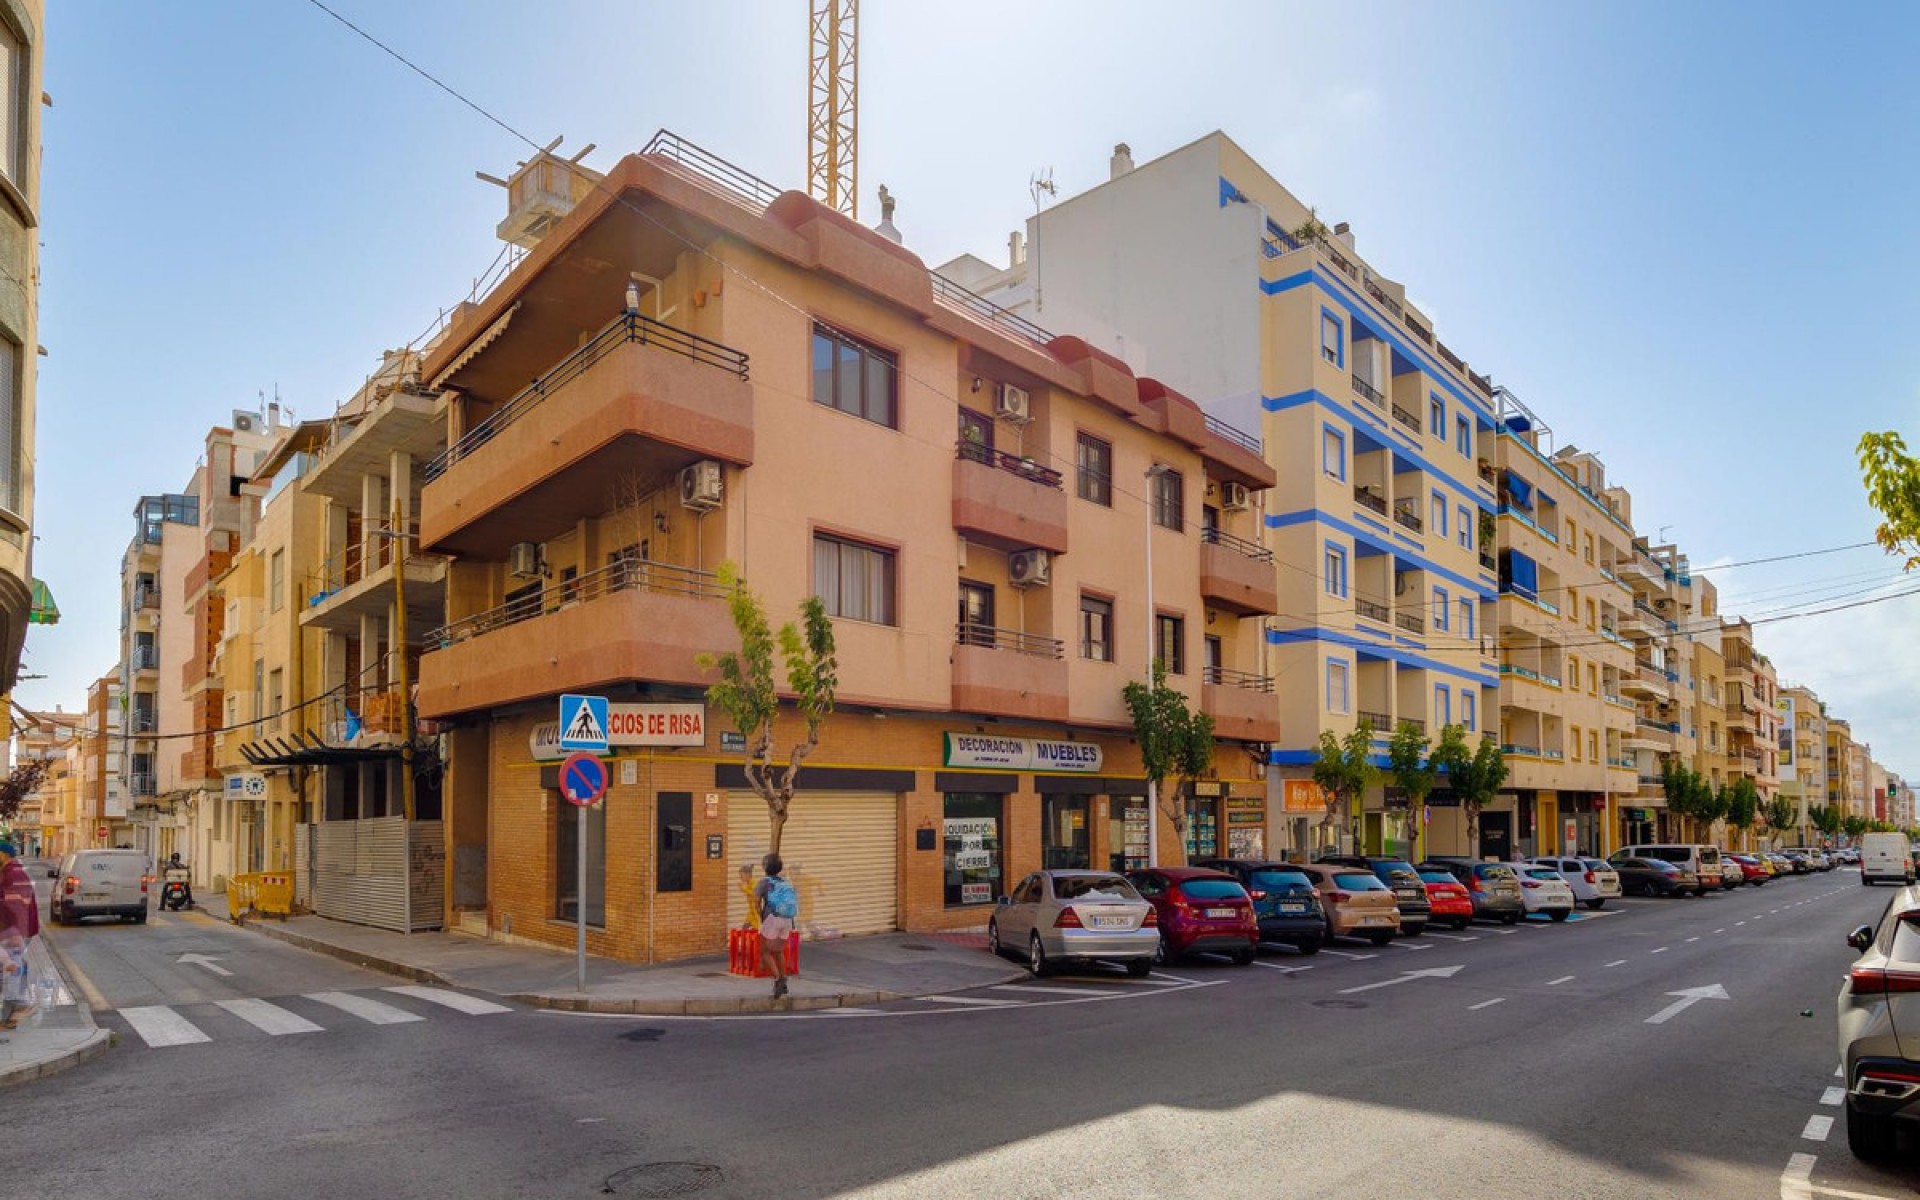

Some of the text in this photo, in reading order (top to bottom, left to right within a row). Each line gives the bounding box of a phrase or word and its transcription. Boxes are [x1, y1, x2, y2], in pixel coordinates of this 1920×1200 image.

[648, 714, 665, 734] DE
[669, 714, 701, 735] RISA
[1037, 743, 1097, 762] MUEBLES
[956, 856, 988, 868] CIERRE
